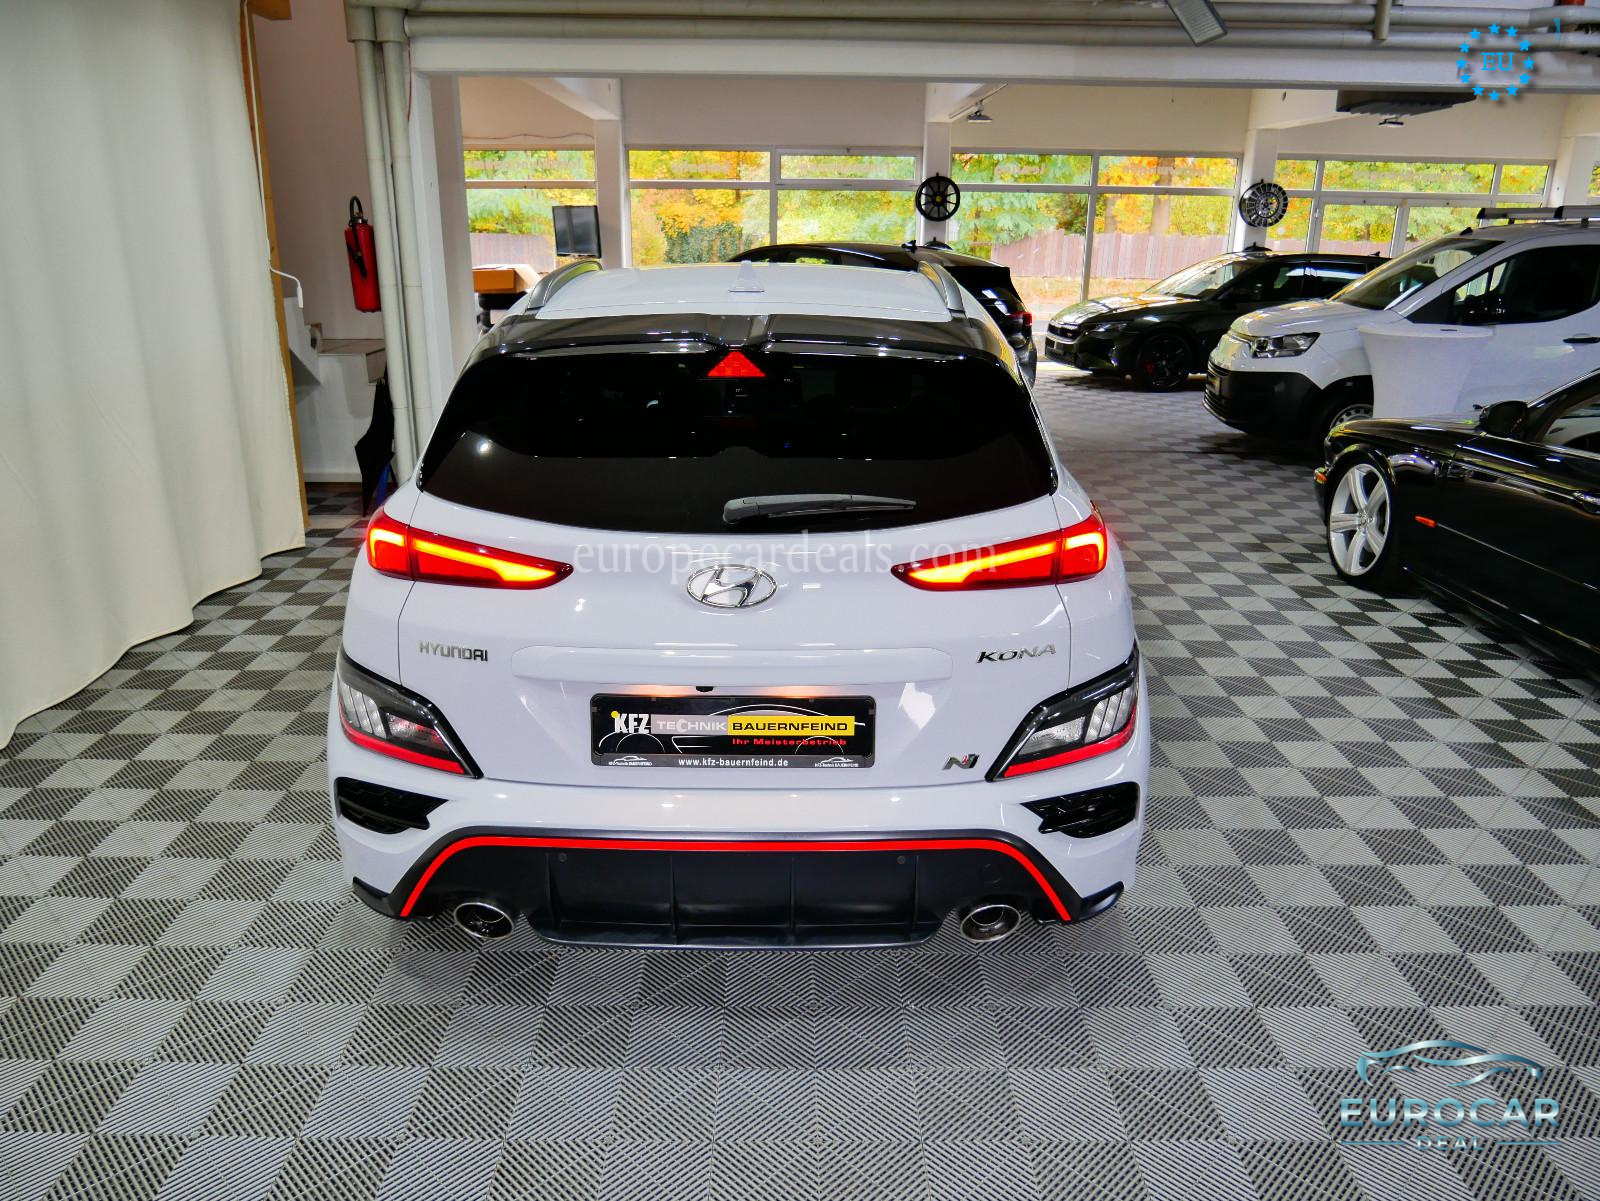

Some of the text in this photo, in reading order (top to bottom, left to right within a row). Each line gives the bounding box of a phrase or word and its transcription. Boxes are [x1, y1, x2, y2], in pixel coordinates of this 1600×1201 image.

[419, 640, 489, 662] HYUNDAI
[976, 644, 1057, 664] KONA
[614, 713, 848, 734] KFZ TECHNIK BAUERNFEIND
[732, 738, 847, 747] Ihr Meisterbetrieb
[678, 757, 789, 767] www.kfz-bauernfeind.de
